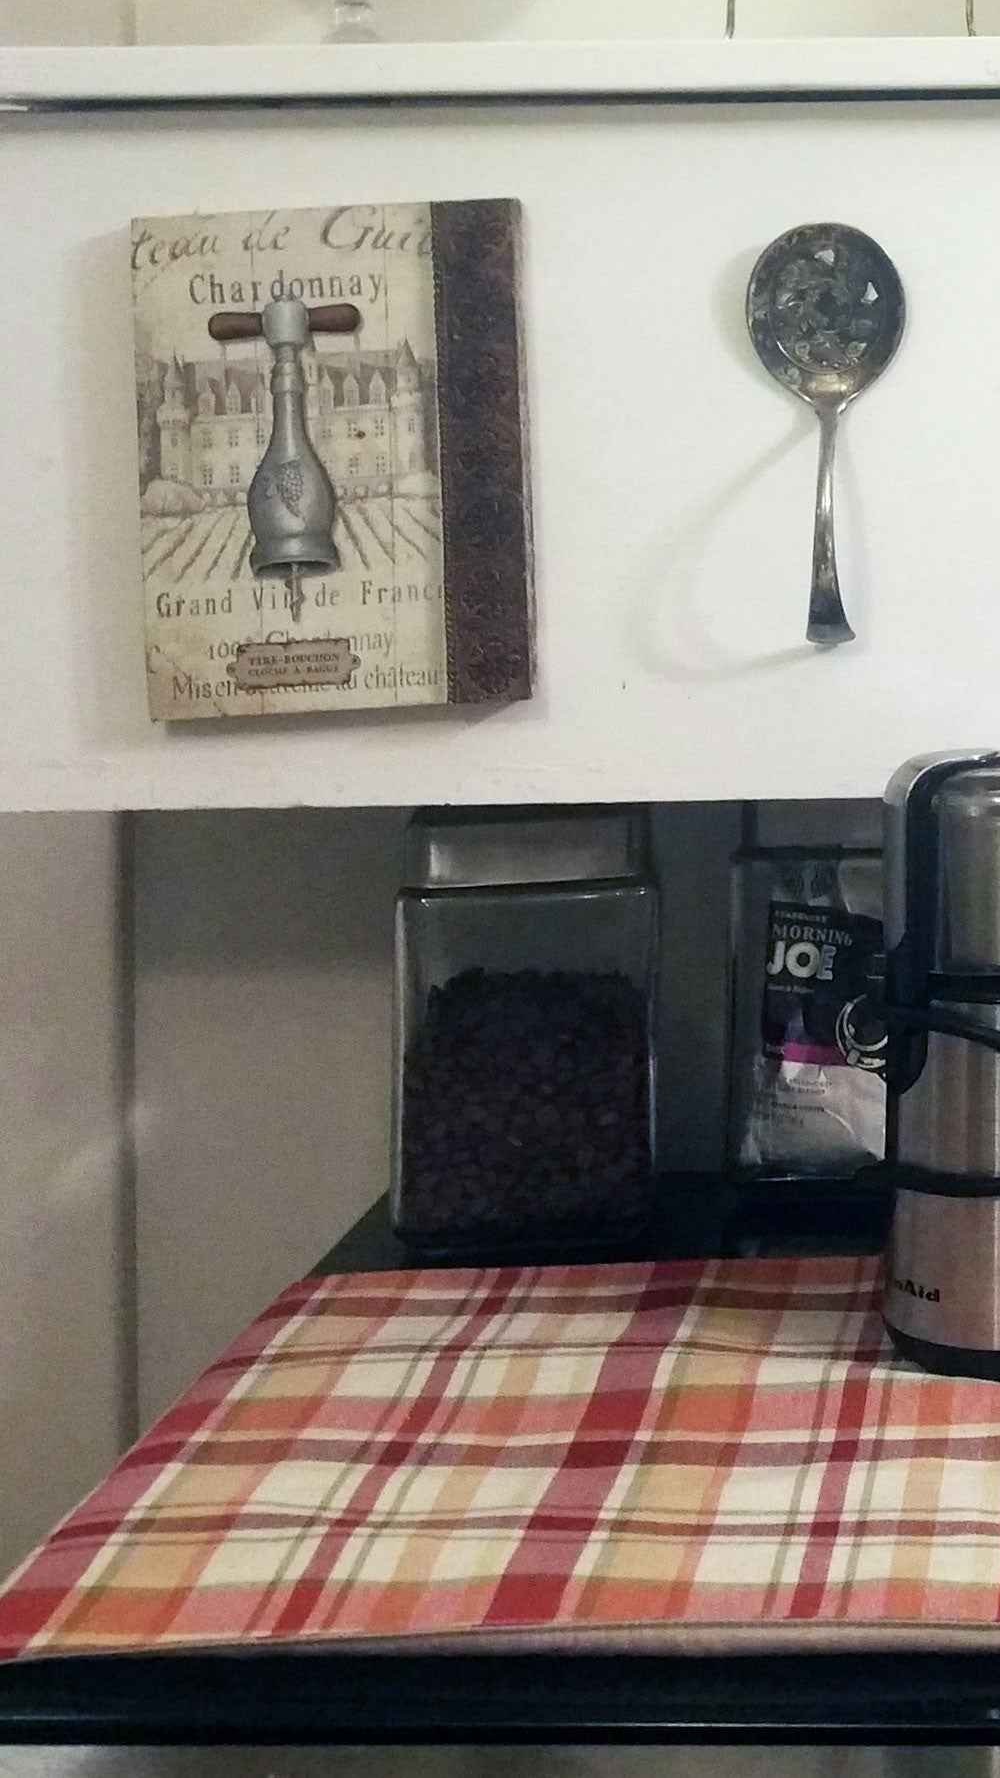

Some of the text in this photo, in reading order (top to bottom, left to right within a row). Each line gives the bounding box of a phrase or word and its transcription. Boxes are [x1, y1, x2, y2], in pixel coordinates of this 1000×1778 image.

[188, 269, 383, 305] Chardonnay
[156, 589, 234, 619] Grand
[314, 582, 342, 609] de
[770, 922, 853, 947] MORNING
[765, 940, 837, 981] JOE
